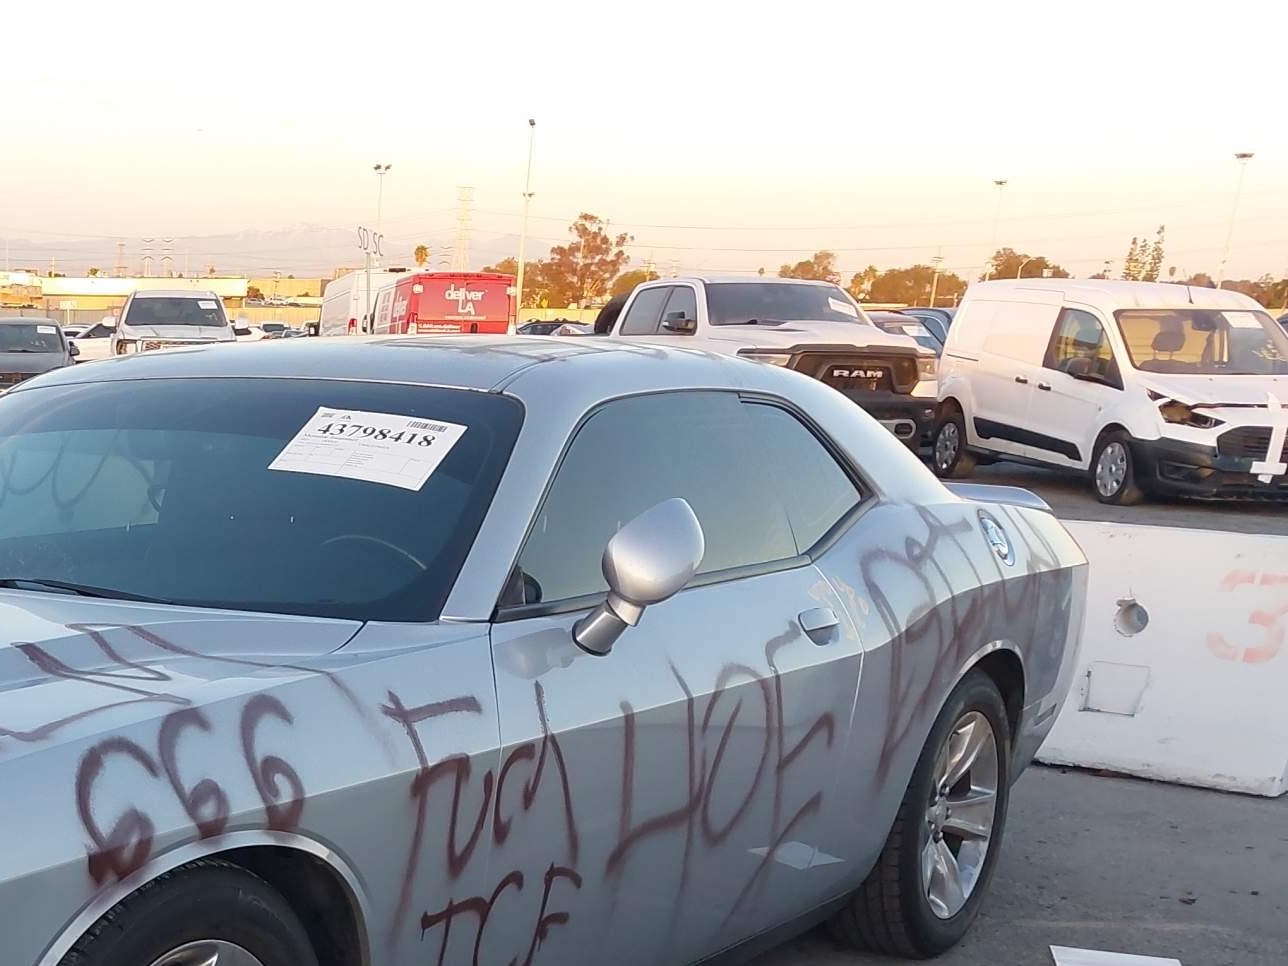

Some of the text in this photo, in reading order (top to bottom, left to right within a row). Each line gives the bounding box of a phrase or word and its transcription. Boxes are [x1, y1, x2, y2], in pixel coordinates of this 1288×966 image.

[445, 284, 485, 300] deliver
[457, 300, 476, 315] LA
[833, 369, 883, 378] RAM
[317, 421, 437, 448] 43798418
[74, 693, 308, 889] 666
